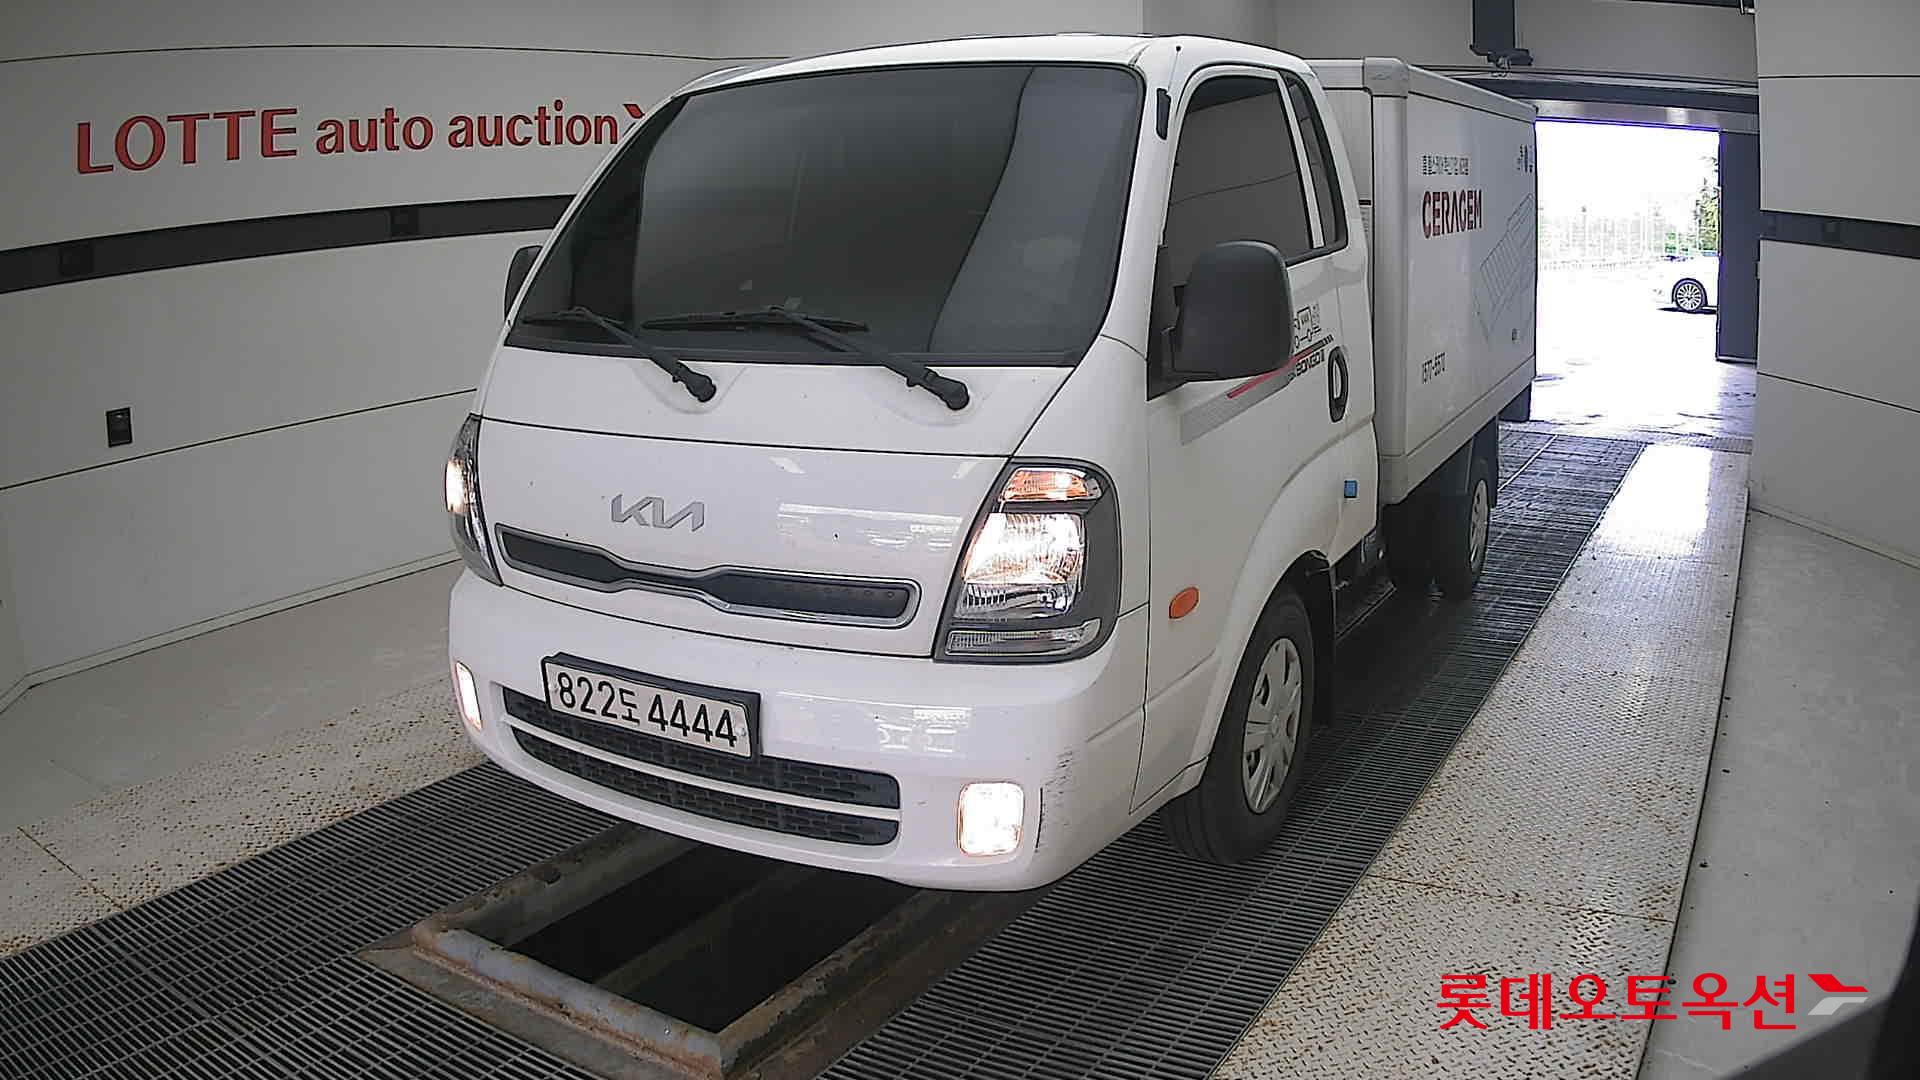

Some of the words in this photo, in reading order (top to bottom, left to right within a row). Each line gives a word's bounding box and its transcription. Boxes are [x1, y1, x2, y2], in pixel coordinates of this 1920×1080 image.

[77, 108, 298, 174] LOTTE
[316, 106, 434, 154] auto
[448, 99, 618, 148] auction
[1422, 189, 1482, 239] CERAGEM
[611, 494, 705, 533] KIA
[648, 693, 738, 748] 4444
